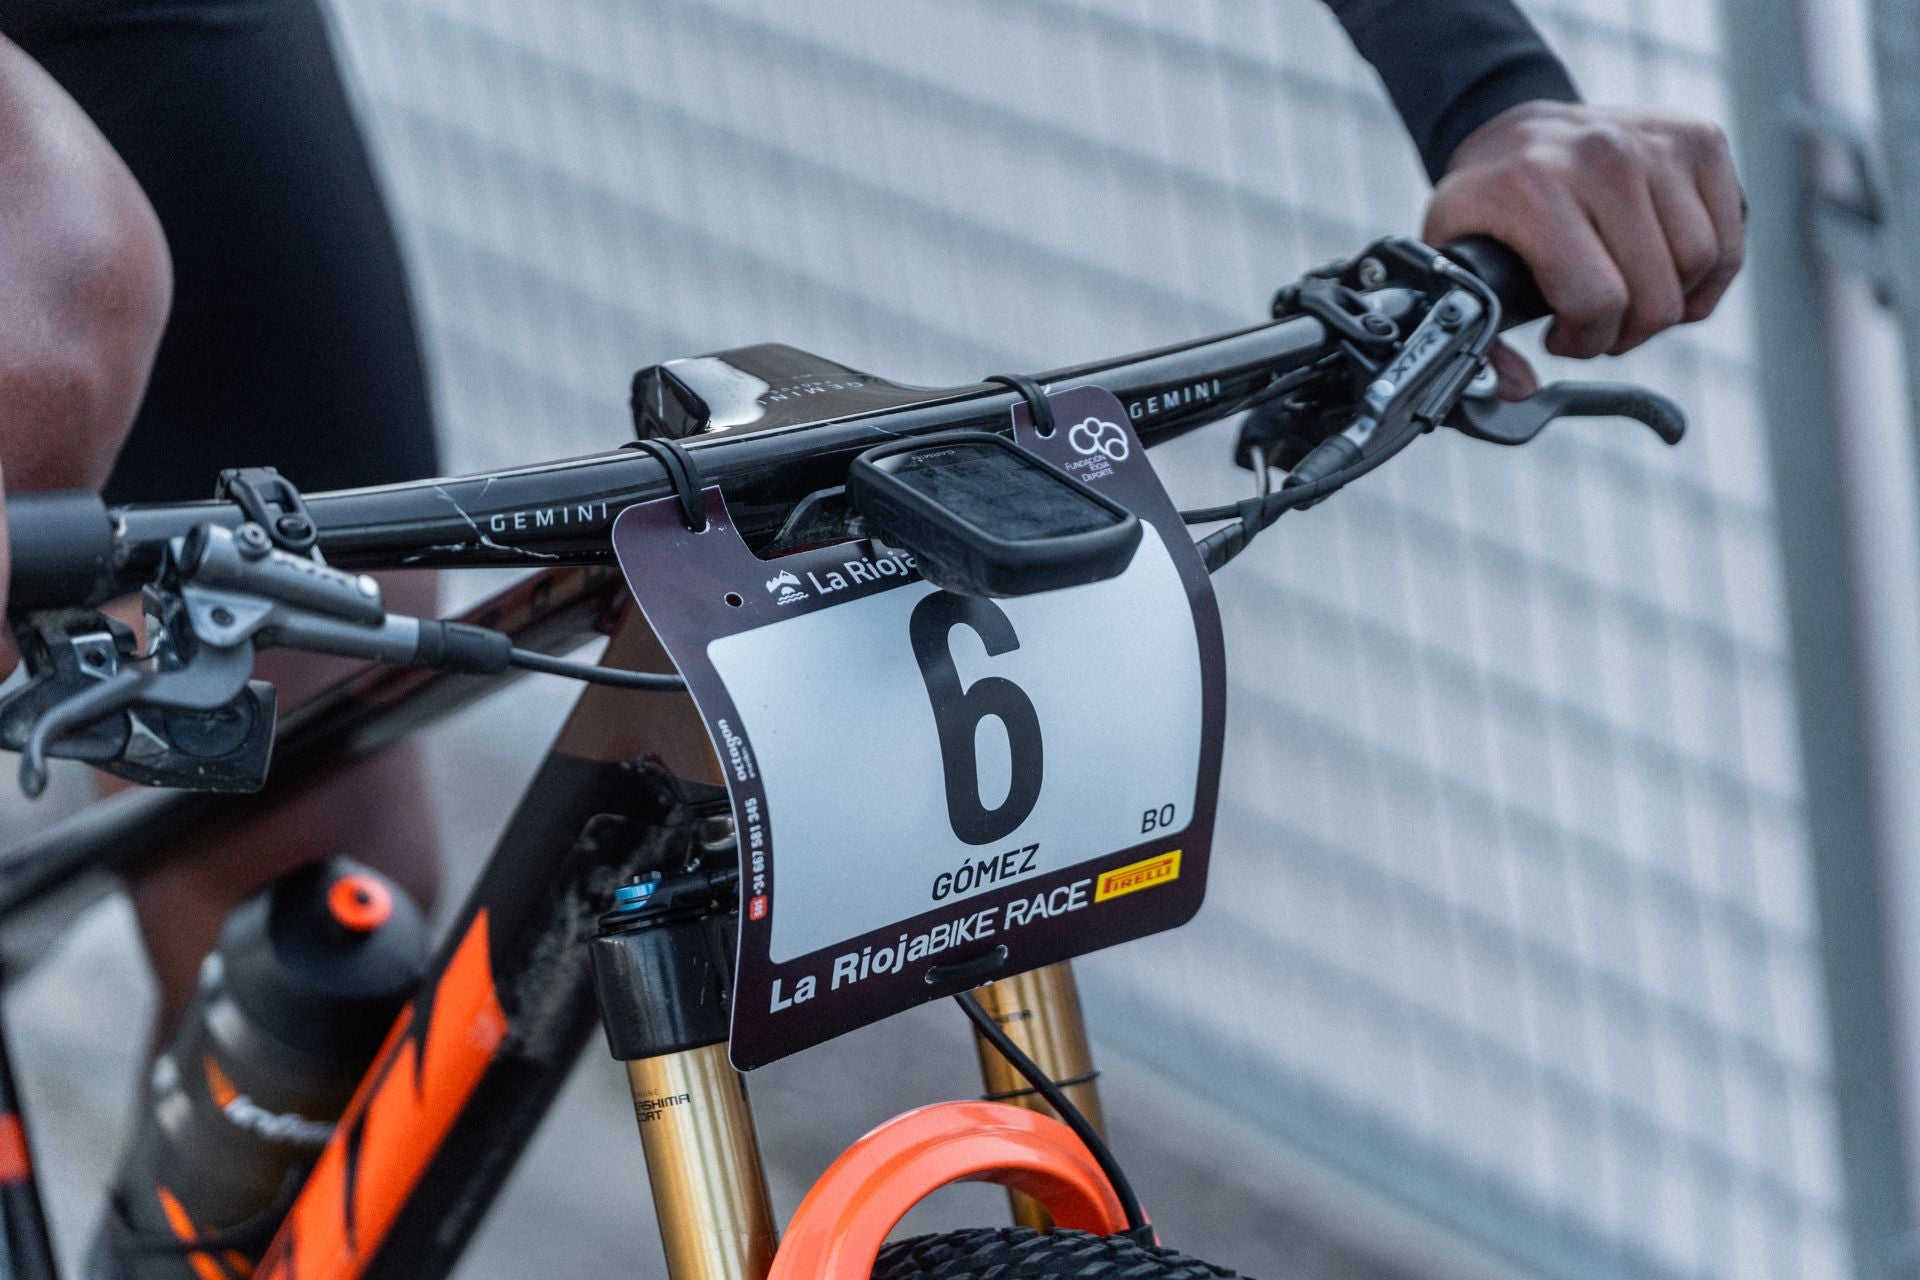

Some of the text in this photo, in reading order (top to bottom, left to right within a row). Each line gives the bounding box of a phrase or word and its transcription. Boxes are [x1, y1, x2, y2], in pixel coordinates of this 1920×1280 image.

[1391, 330, 1437, 382] XTR
[759, 381, 864, 405] GEMINI
[1129, 379, 1221, 419] GEMINI
[490, 502, 607, 532] GEMINI
[807, 571, 848, 595] La
[909, 588, 1043, 846] 6
[718, 719, 747, 781] octagon
[745, 797, 760, 823] 345
[1141, 803, 1175, 834] BO
[749, 825, 763, 848] 581
[752, 851, 765, 873] 667
[932, 843, 1039, 900] GÓMEZ
[1103, 858, 1174, 893] PIRELLI
[769, 976, 816, 1014] La
[1004, 879, 1092, 930] RACE
[636, 1093, 690, 1111] ASHIMA
